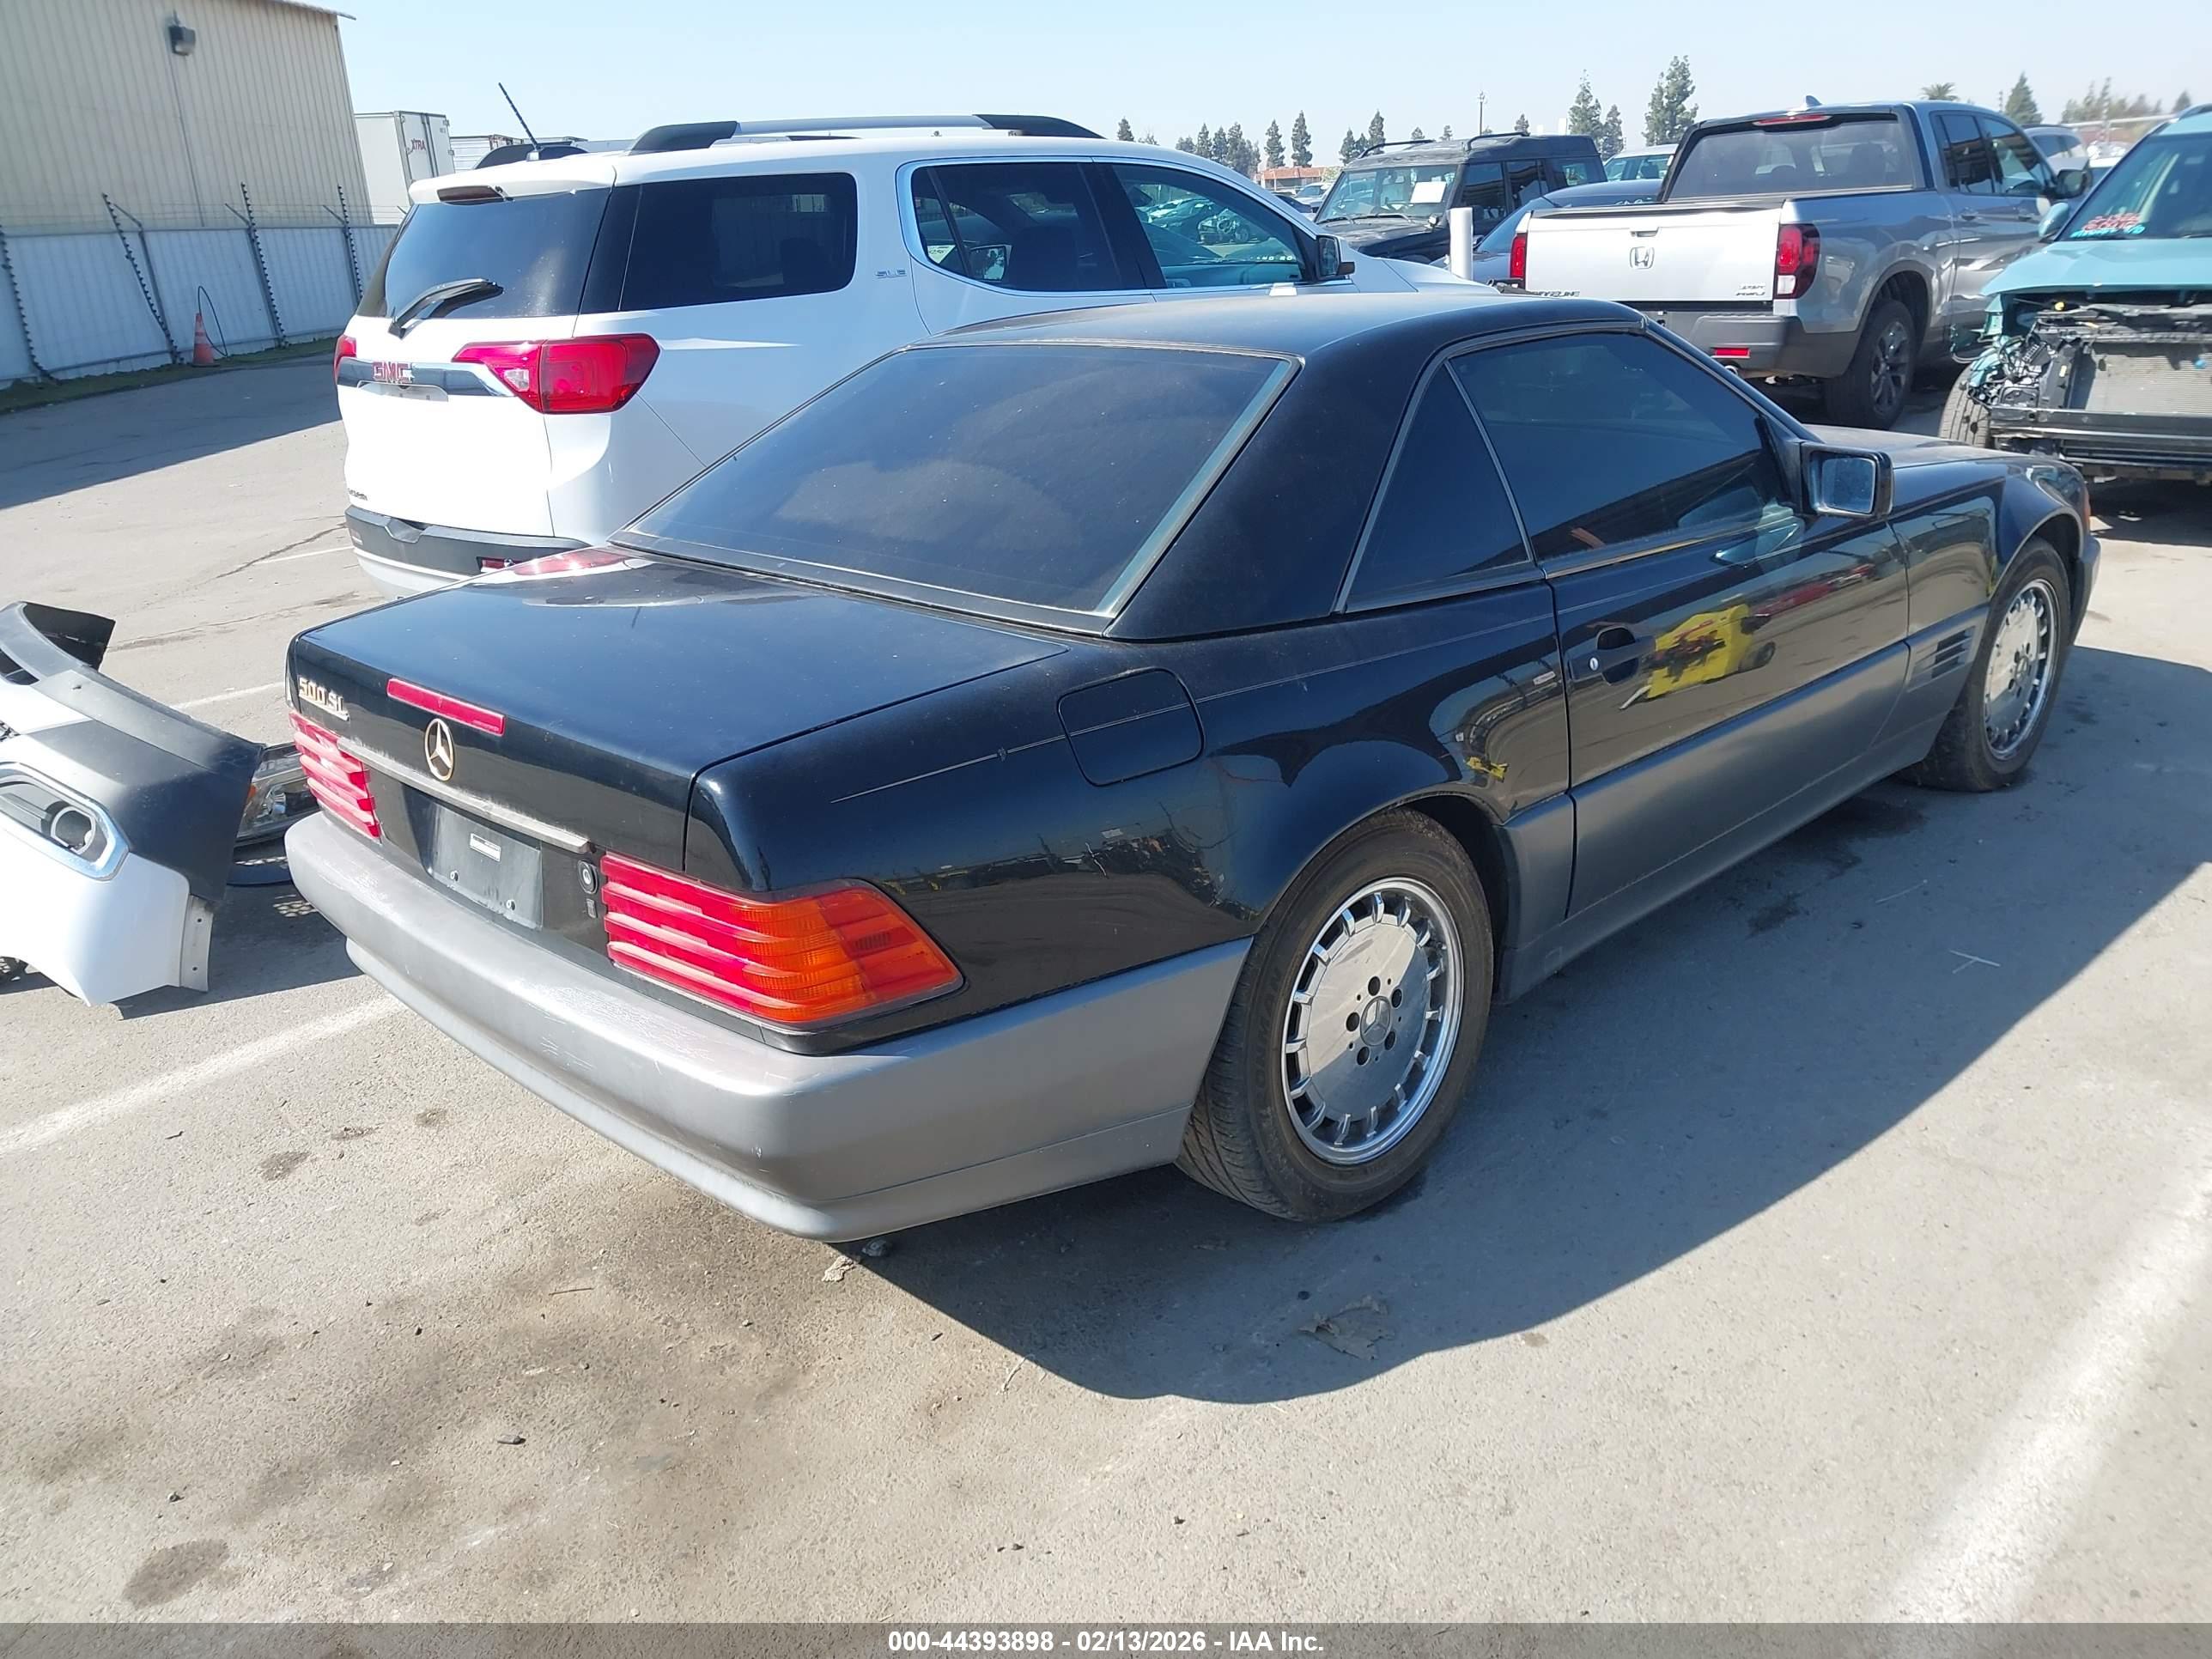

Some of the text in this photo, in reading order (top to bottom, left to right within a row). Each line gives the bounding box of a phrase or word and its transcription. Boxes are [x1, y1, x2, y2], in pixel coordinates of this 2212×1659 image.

[372, 361, 415, 383] GMC
[298, 675, 349, 718] 500 SL
